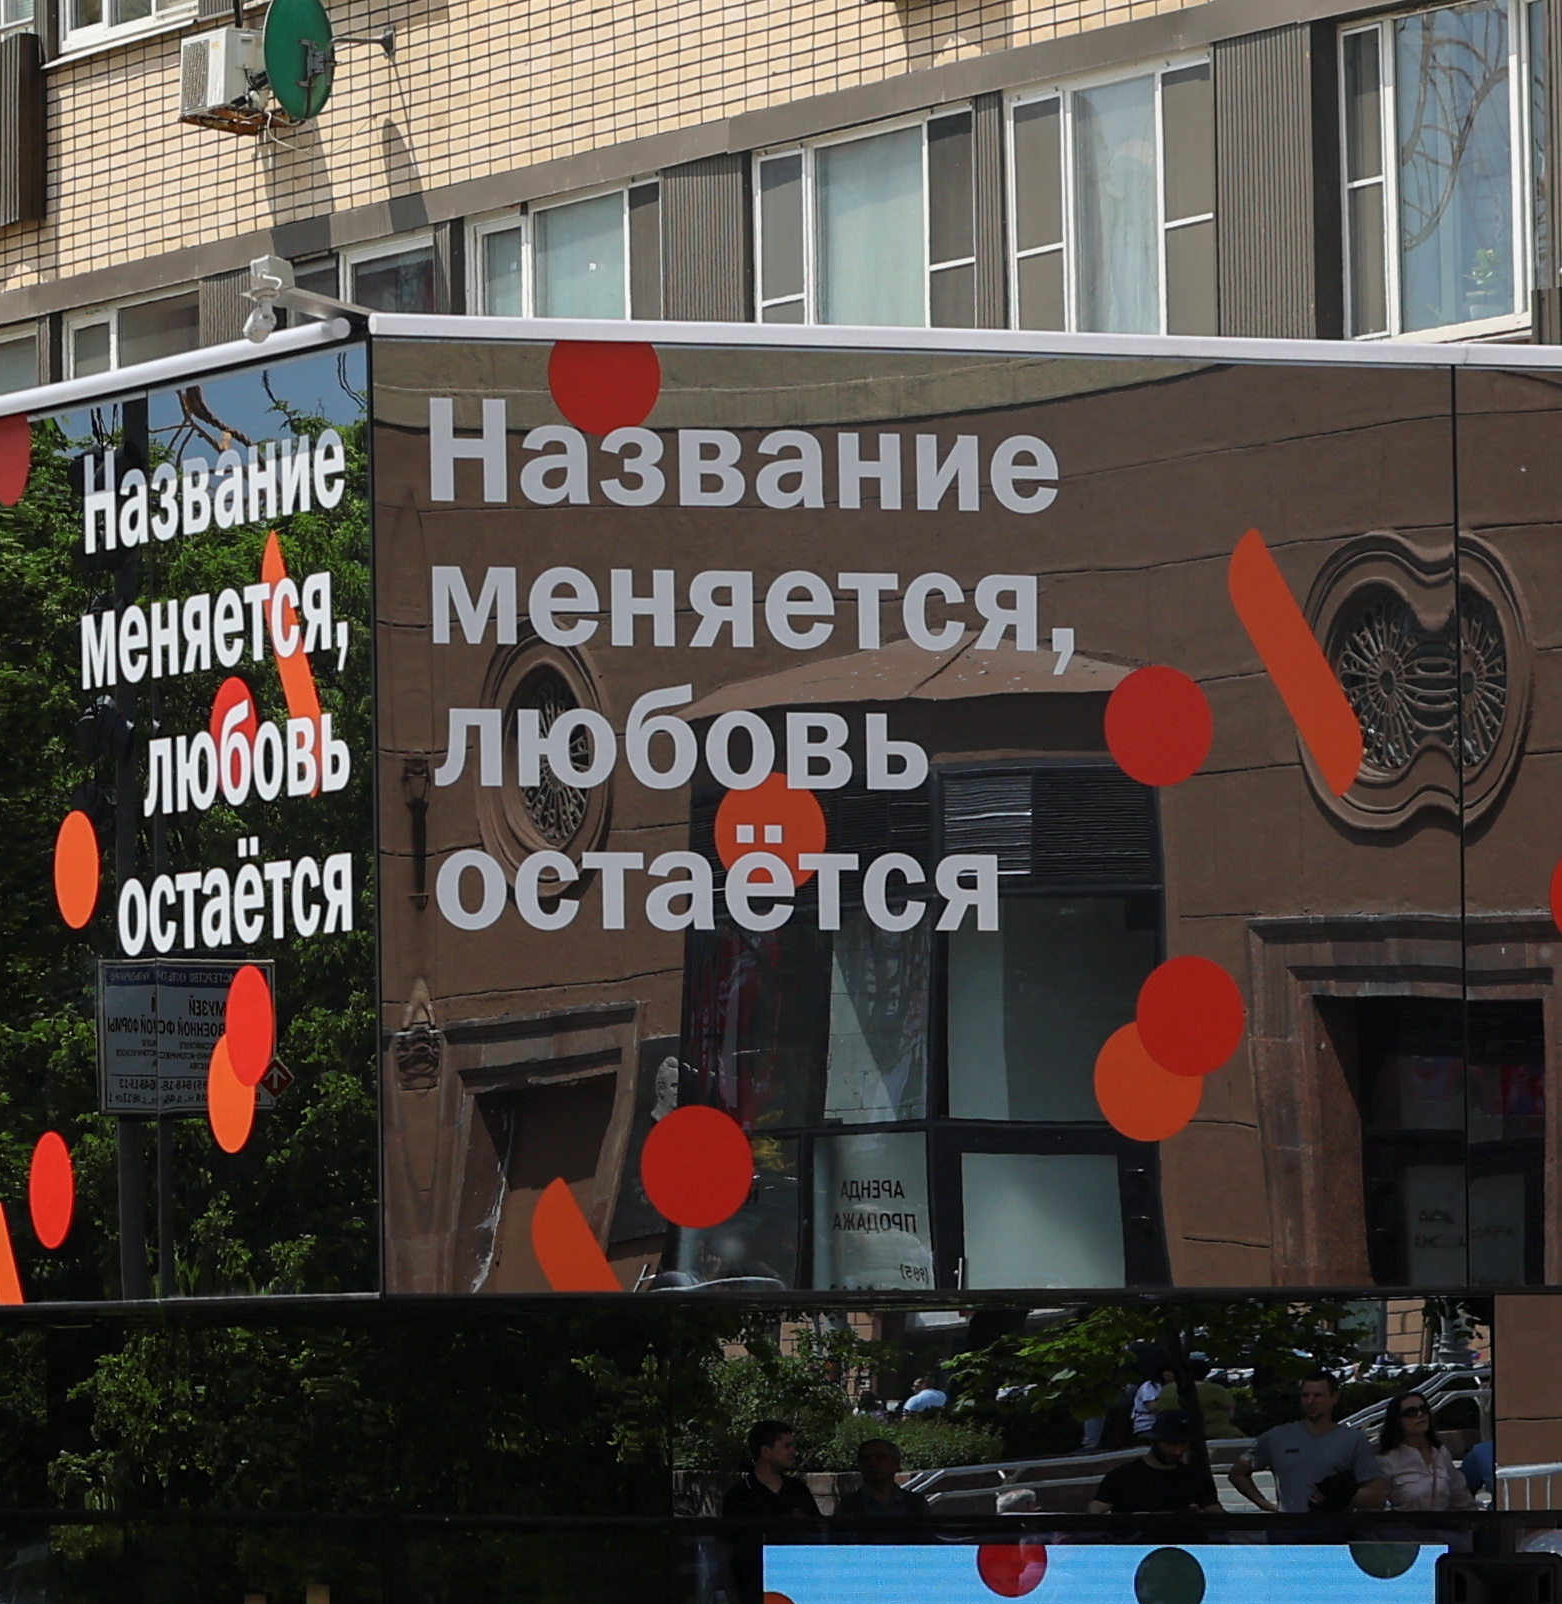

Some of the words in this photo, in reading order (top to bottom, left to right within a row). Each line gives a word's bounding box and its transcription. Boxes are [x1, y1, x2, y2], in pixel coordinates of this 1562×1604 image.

[83, 427, 346, 555] Название
[428, 397, 1060, 515] Название
[80, 571, 349, 691] меняется,
[430, 564, 1077, 675] меняется,
[143, 700, 351, 817] любовь
[435, 684, 930, 791] любовь
[117, 836, 354, 957] остаётся
[435, 824, 999, 933] остаётся
